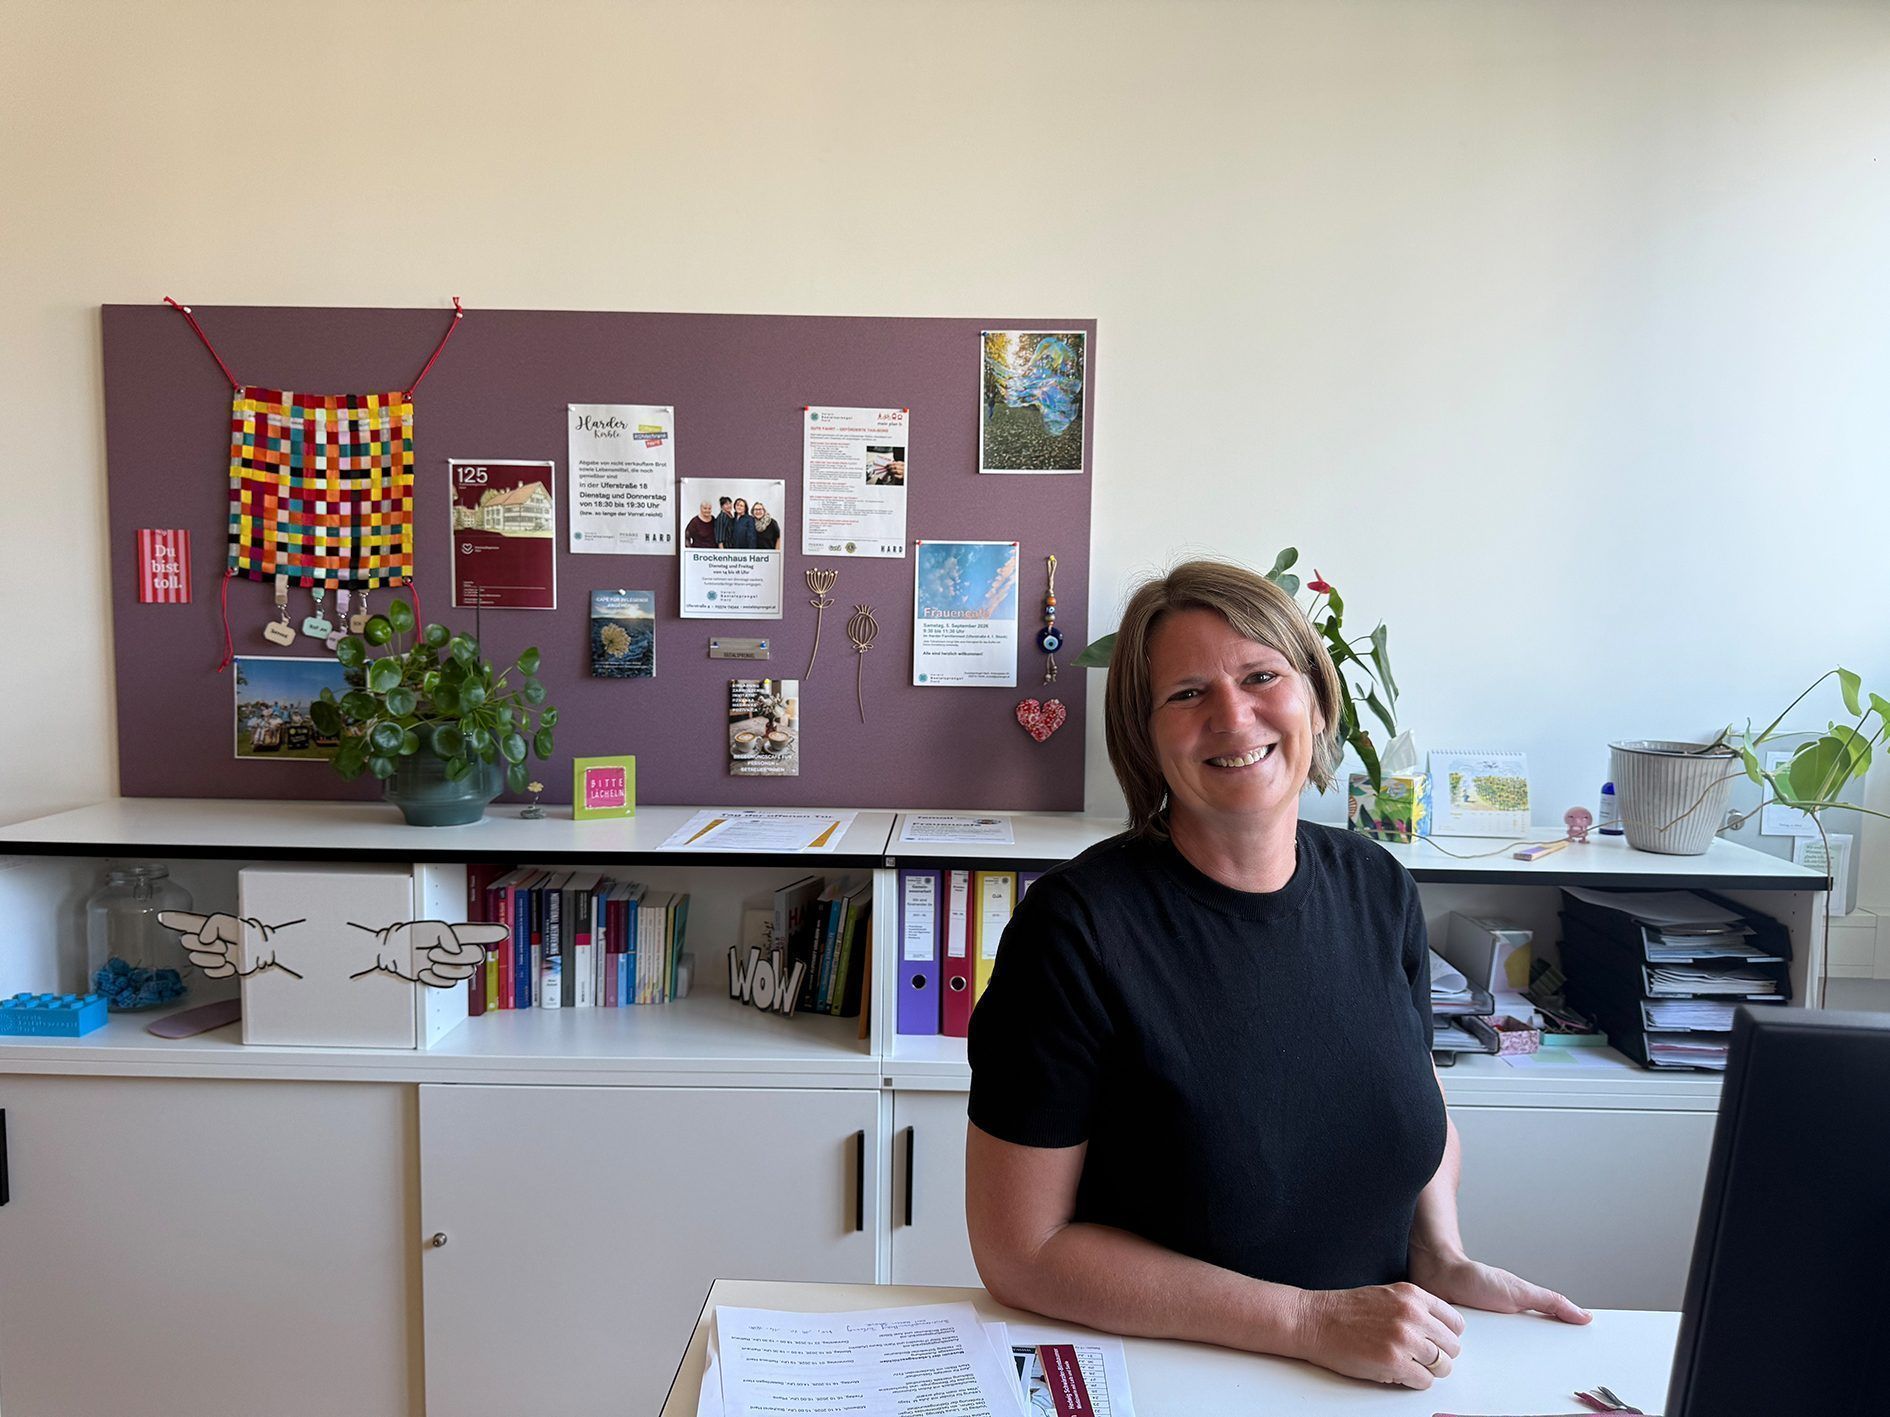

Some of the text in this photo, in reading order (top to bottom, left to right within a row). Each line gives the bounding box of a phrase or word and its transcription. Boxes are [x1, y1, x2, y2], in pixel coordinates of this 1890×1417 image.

[575, 415, 628, 432] Harder
[457, 467, 488, 483] 125
[579, 491, 610, 500] Dienstag
[626, 492, 667, 501] Donnerstag
[645, 533, 671, 542] HARD
[155, 544, 176, 558] Du
[880, 545, 903, 554] HARD
[693, 553, 769, 563] Brockenhaus Hard
[151, 559, 180, 573] bist
[153, 575, 183, 589] toll.
[591, 778, 623, 788] BITTE
[591, 788, 624, 799] LÄCHELN
[728, 945, 806, 1017] WOW
